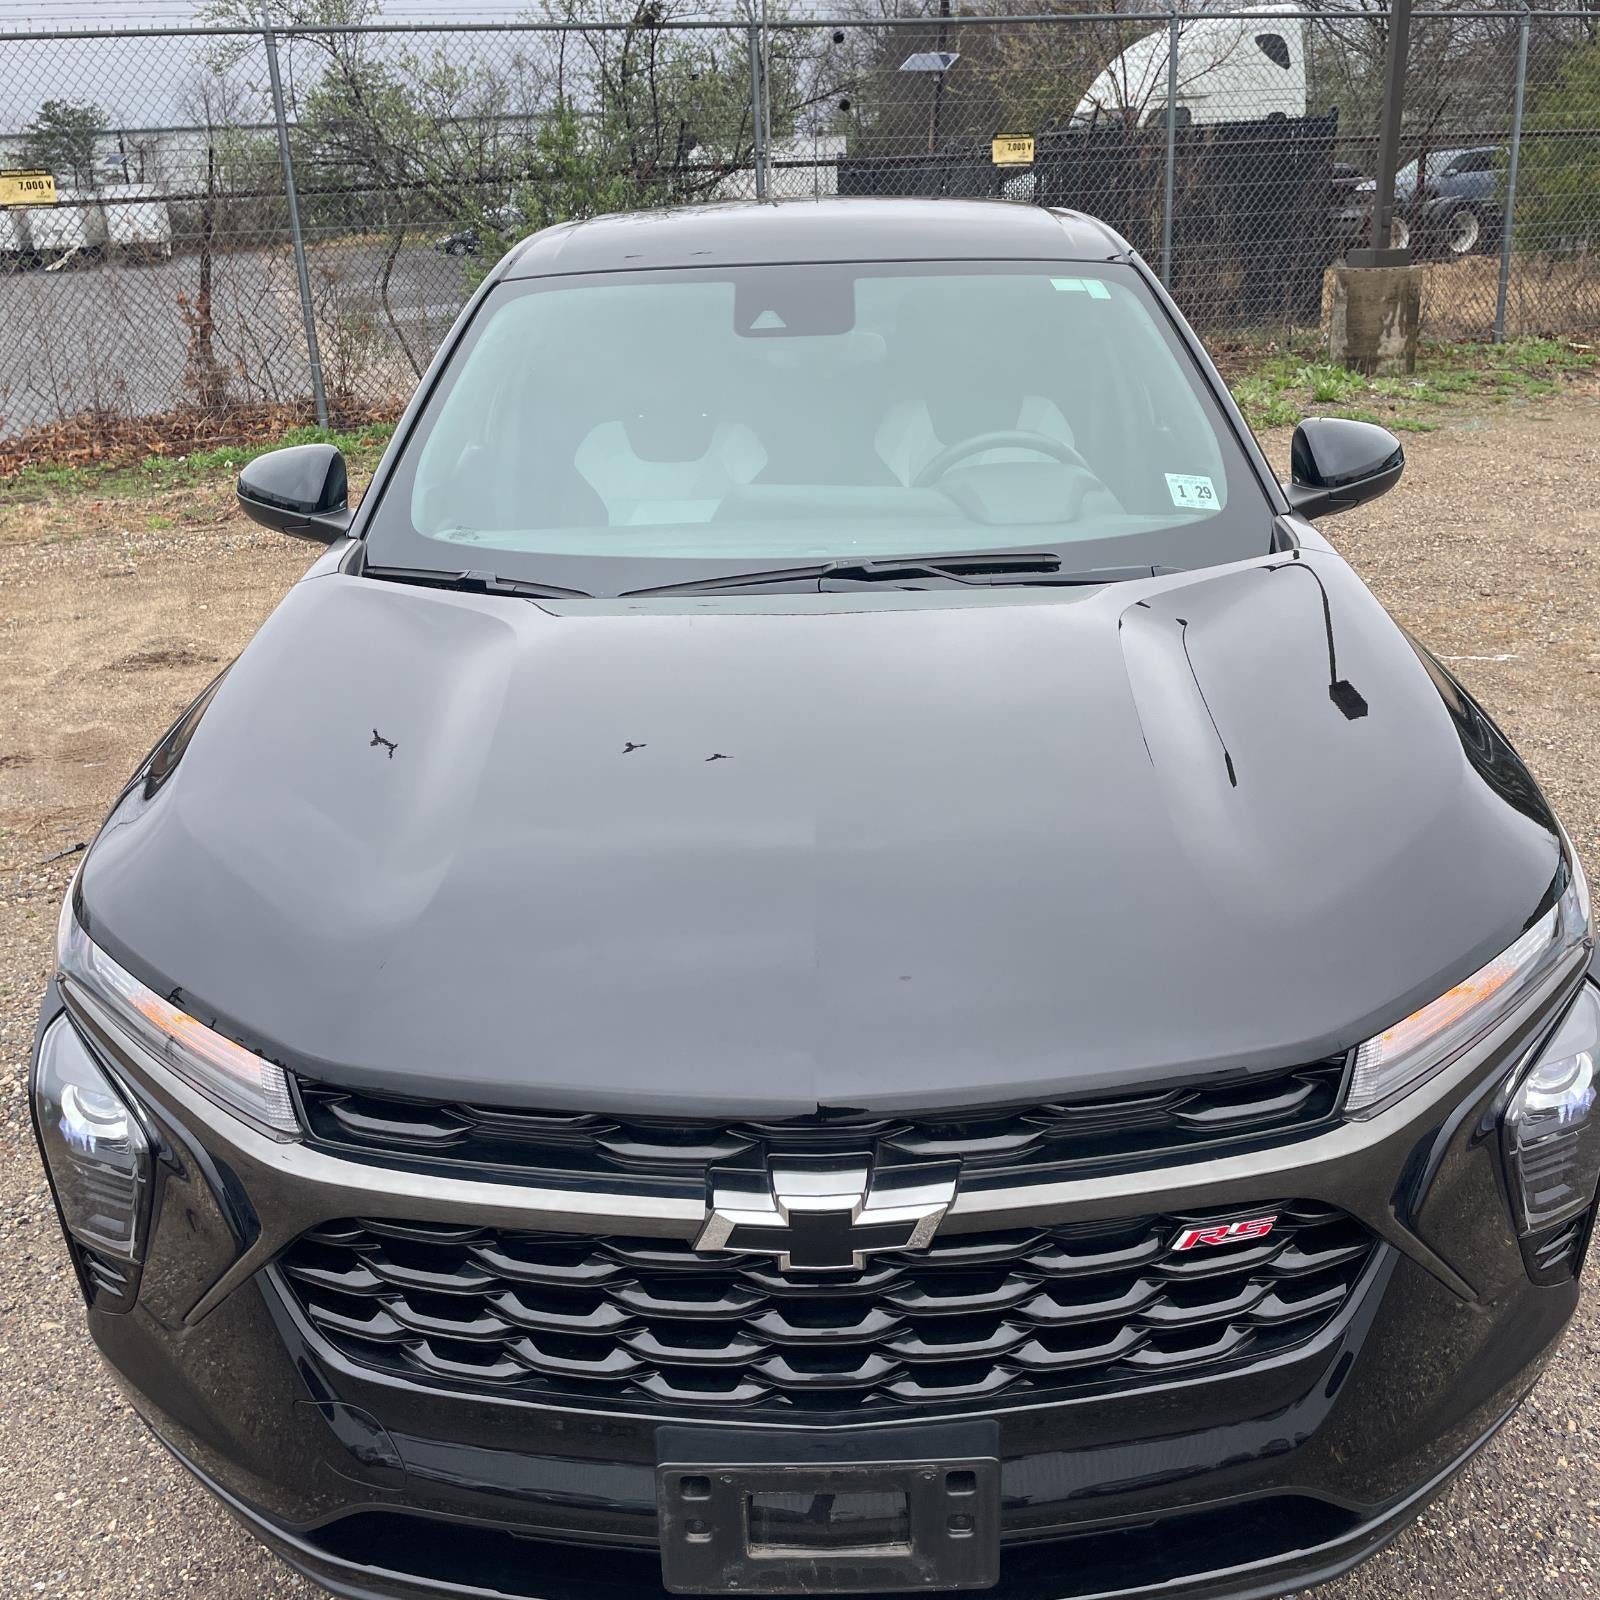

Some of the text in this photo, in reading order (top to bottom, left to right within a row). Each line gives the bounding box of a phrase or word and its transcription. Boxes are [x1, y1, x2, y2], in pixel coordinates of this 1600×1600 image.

[1007, 141, 1032, 152] 7,000 V
[18, 180, 52, 191] 7,000 V
[1178, 485, 1212, 499] 1 29
[1171, 1215, 1278, 1251] RS
